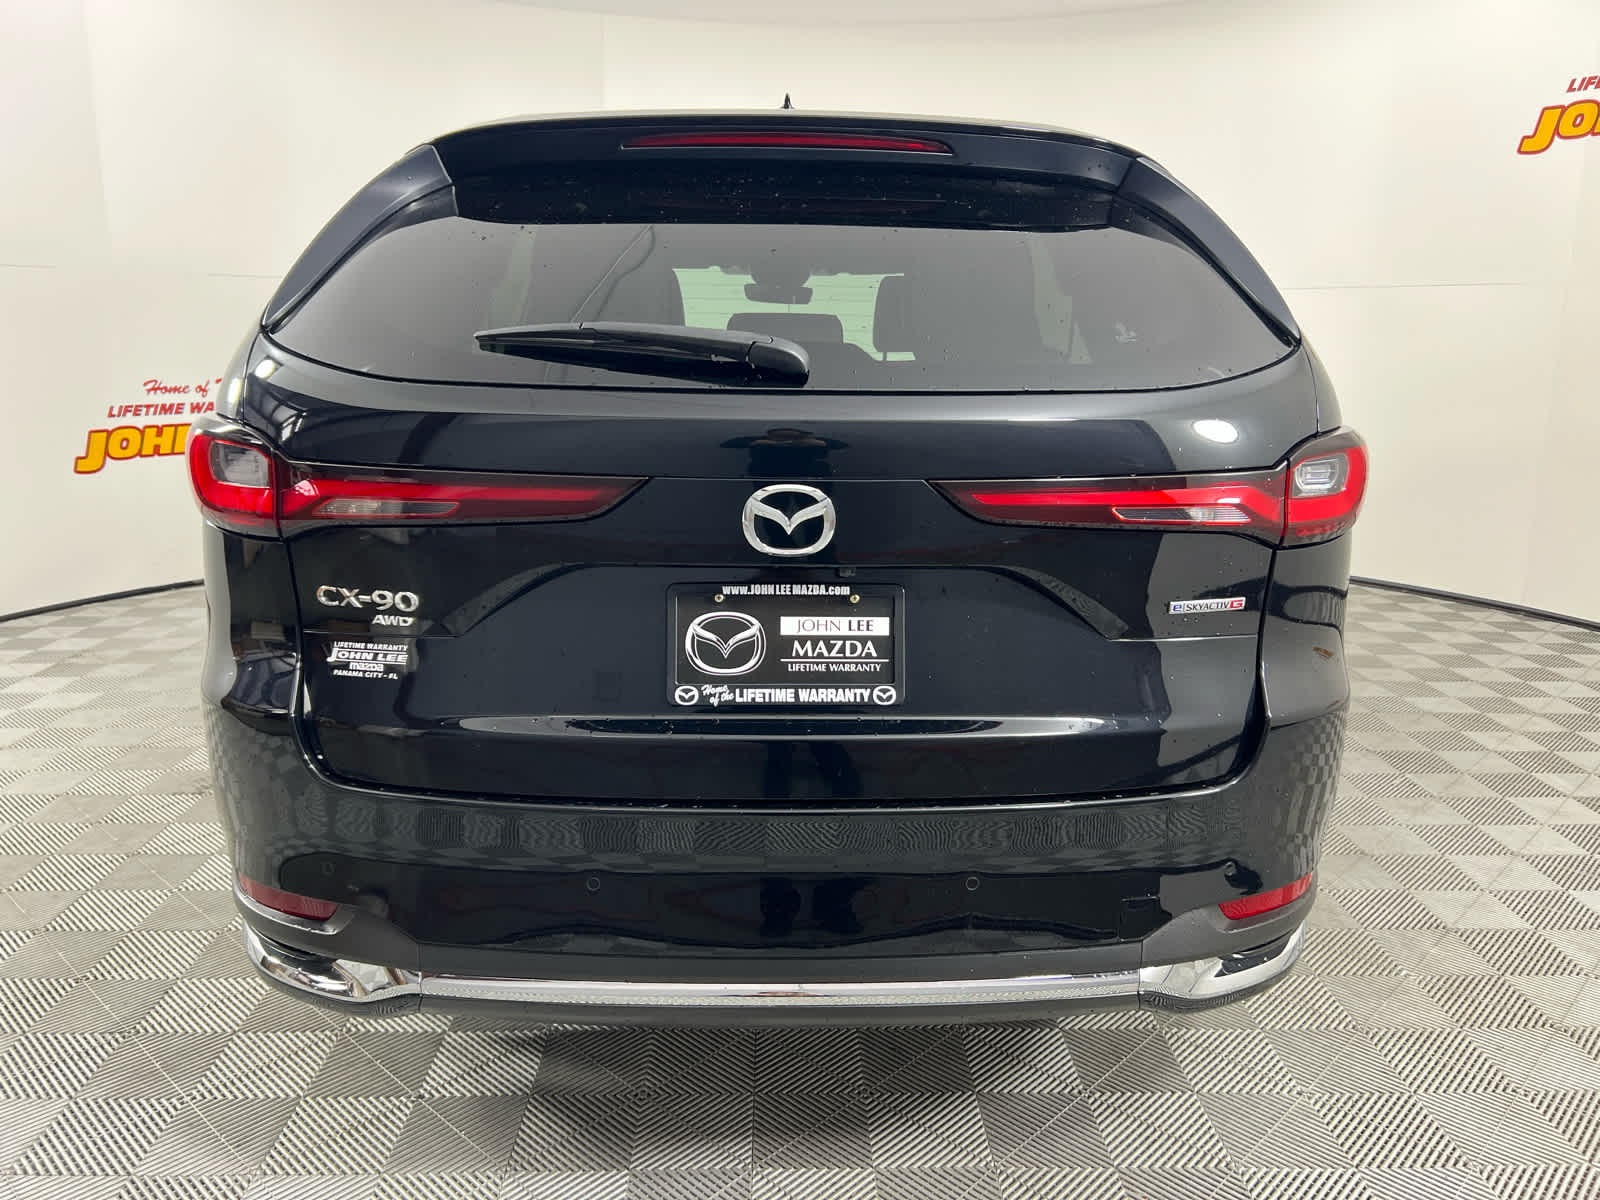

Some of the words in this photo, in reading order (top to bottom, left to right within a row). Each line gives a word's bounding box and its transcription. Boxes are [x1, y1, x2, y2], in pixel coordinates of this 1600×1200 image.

[143, 379, 191, 395] Home
[195, 380, 210, 398] of
[107, 403, 185, 418] LIFETIME
[316, 585, 420, 612] CX-90
[371, 614, 415, 627] AWD
[796, 619, 841, 632] JOHN
[847, 619, 874, 632] LEE
[333, 641, 365, 649] LIFETIME
[366, 643, 409, 652] WARRANTY
[791, 640, 878, 657] MAZDA
[326, 648, 374, 662] JOHN
[376, 654, 409, 662] LEE
[333, 669, 364, 678] PANAMA
[787, 664, 827, 672] LIFETIME
[829, 664, 881, 672] WARRANTY
[701, 684, 729, 696] Home
[735, 688, 796, 702] LIFETIME
[798, 688, 871, 702] WARRANTY
